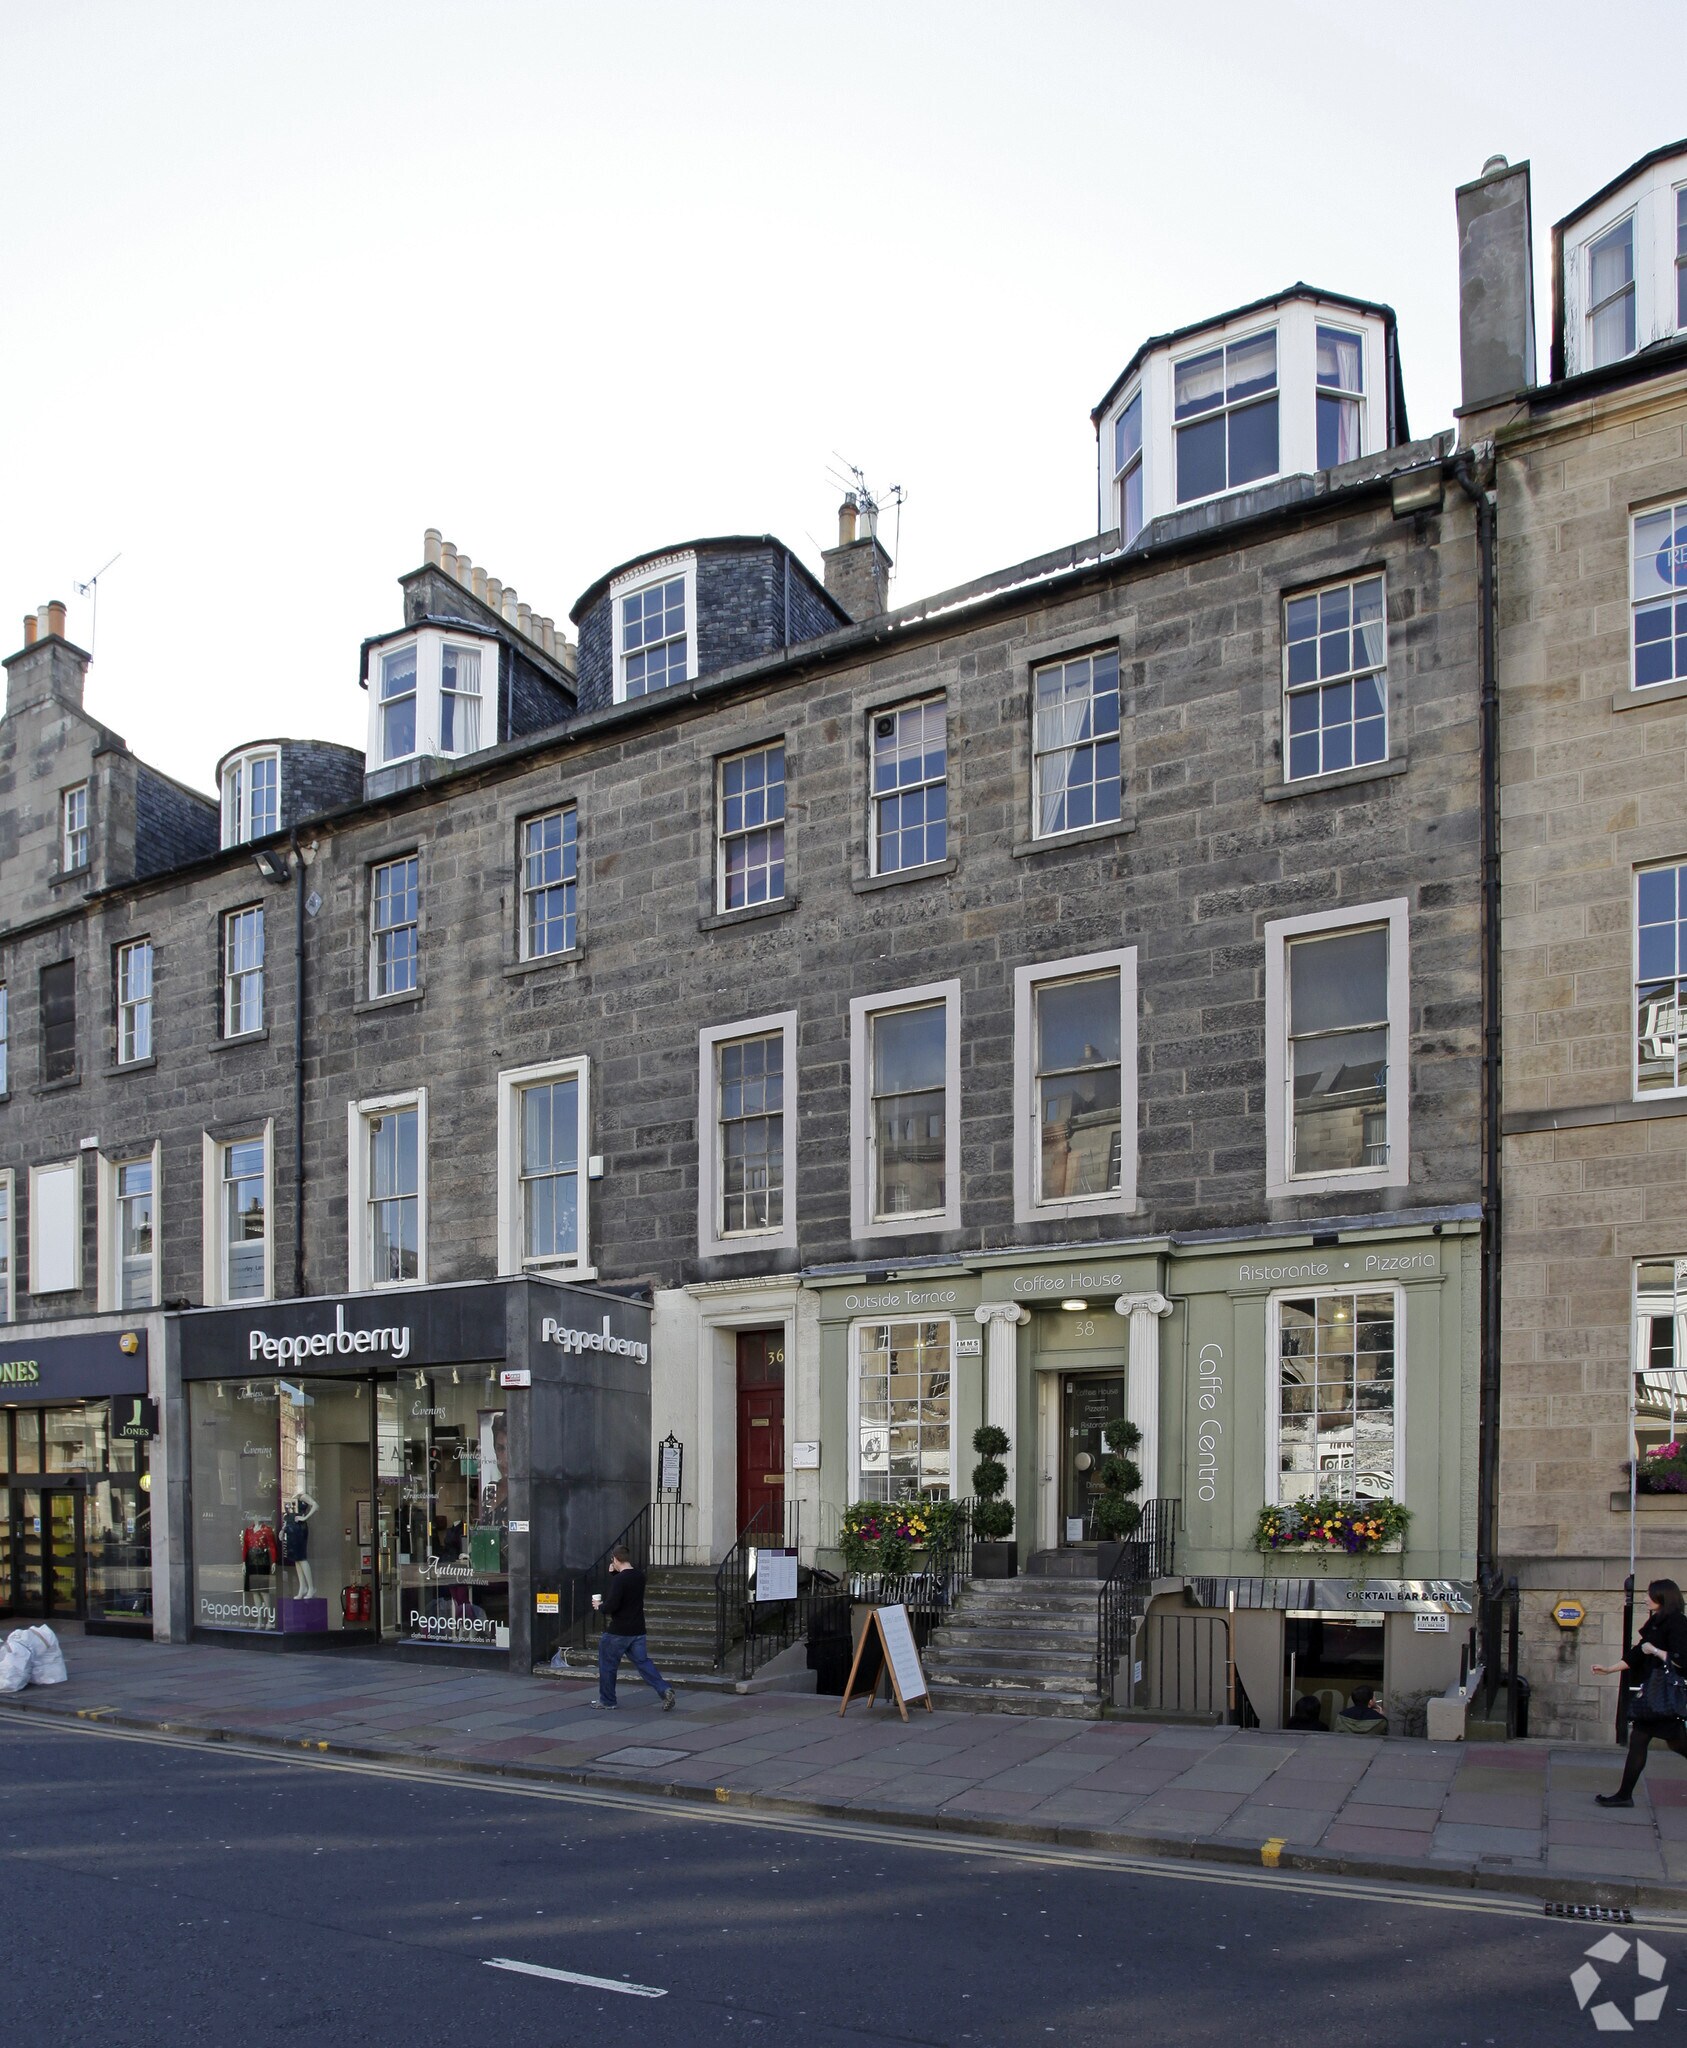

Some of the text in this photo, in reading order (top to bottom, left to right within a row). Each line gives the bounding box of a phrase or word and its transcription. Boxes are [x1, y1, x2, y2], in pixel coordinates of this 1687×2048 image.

[1239, 1252, 1435, 1281] Ristorante Pizzeria
[1013, 1272, 1123, 1292] Coffee House
[845, 1290, 957, 1310] Outside Terrace
[250, 1303, 410, 1368] Pepperberry
[1074, 1320, 1095, 1337] 38
[541, 1315, 649, 1365] Pepperberry
[768, 1349, 785, 1366] 36
[0, 1360, 39, 1383] NES
[412, 1400, 446, 1419] Evening
[119, 1426, 150, 1437] JONES
[1198, 1343, 1223, 1502] Caffe Centro
[243, 1440, 273, 1458] Evening
[418, 1555, 475, 1578] Autumn
[201, 1590, 276, 1623] Pepperberry
[1346, 1591, 1463, 1602] COCKTAIL BAR & GRILL
